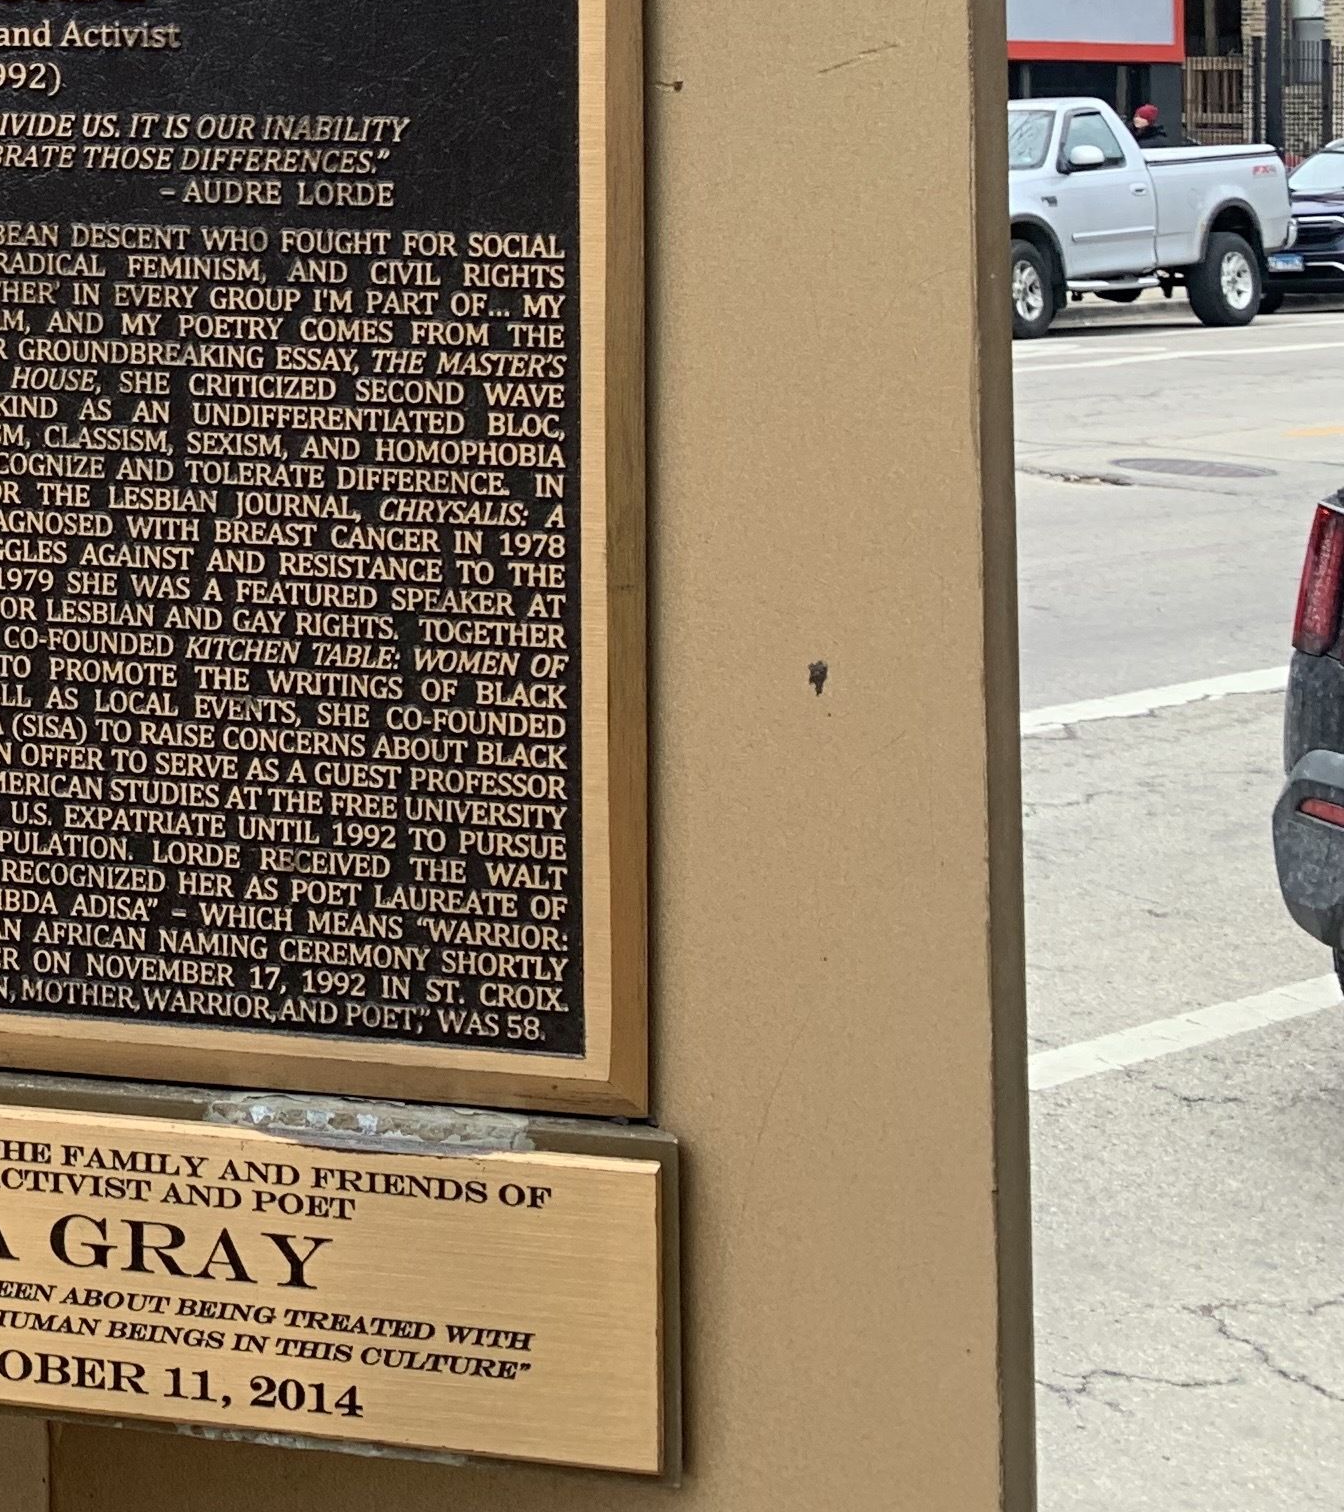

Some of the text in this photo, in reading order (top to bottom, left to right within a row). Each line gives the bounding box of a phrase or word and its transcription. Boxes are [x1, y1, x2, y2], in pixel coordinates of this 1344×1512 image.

[59, 20, 181, 48] Activist
[81, 112, 121, 138] US.
[128, 112, 161, 138] IT
[162, 113, 191, 139] IS
[195, 113, 256, 140] OUR
[262, 115, 411, 142] INABILITY
[82, 144, 175, 170] THOSE
[179, 147, 391, 174] DIFFERENCES.”
[181, 179, 282, 205] AUDRE
[297, 180, 395, 207] LORDE
[70, 223, 191, 250] DESCENT
[200, 226, 268, 252] WHO
[281, 229, 392, 255] FOUGHT
[402, 230, 458, 257] FOR
[468, 232, 566, 259] SOCIAL
[78, 397, 112, 422] AS
[131, 400, 170, 424] AN
[192, 403, 465, 434] UNDIFFERENTIATED
[487, 412, 566, 440] BLOC,
[44, 686, 79, 711] AS
[94, 688, 179, 716] LOCAL
[194, 694, 302, 725] EVENTS,
[317, 702, 370, 728] SHE
[386, 706, 566, 739] CO-FOUNDED
[152, 840, 241, 869] LORDE
[259, 847, 391, 878] RECEIVED
[409, 857, 467, 884] THE
[484, 862, 568, 891] WALT
[60, 1144, 209, 1178] FAMILY
[217, 1160, 301, 1186] AND
[310, 1167, 488, 1204] FRIENDS
[498, 1183, 552, 1209] OF
[159, 1183, 242, 1209] AND
[251, 1190, 356, 1221] POET
[49, 1214, 334, 1289] GRAY
[58, 1288, 172, 1314] ABOUT
[174, 1298, 277, 1324] BEING
[283, 1309, 437, 1340] TREATED
[444, 1324, 536, 1352] WITH
[104, 1320, 226, 1349] BEINGS
[230, 1333, 271, 1354] IN
[274, 1338, 354, 1363] THIS
[359, 1347, 532, 1380] CULTURE”
[163, 1367, 232, 1407] 11,
[249, 1376, 364, 1418] 2014
